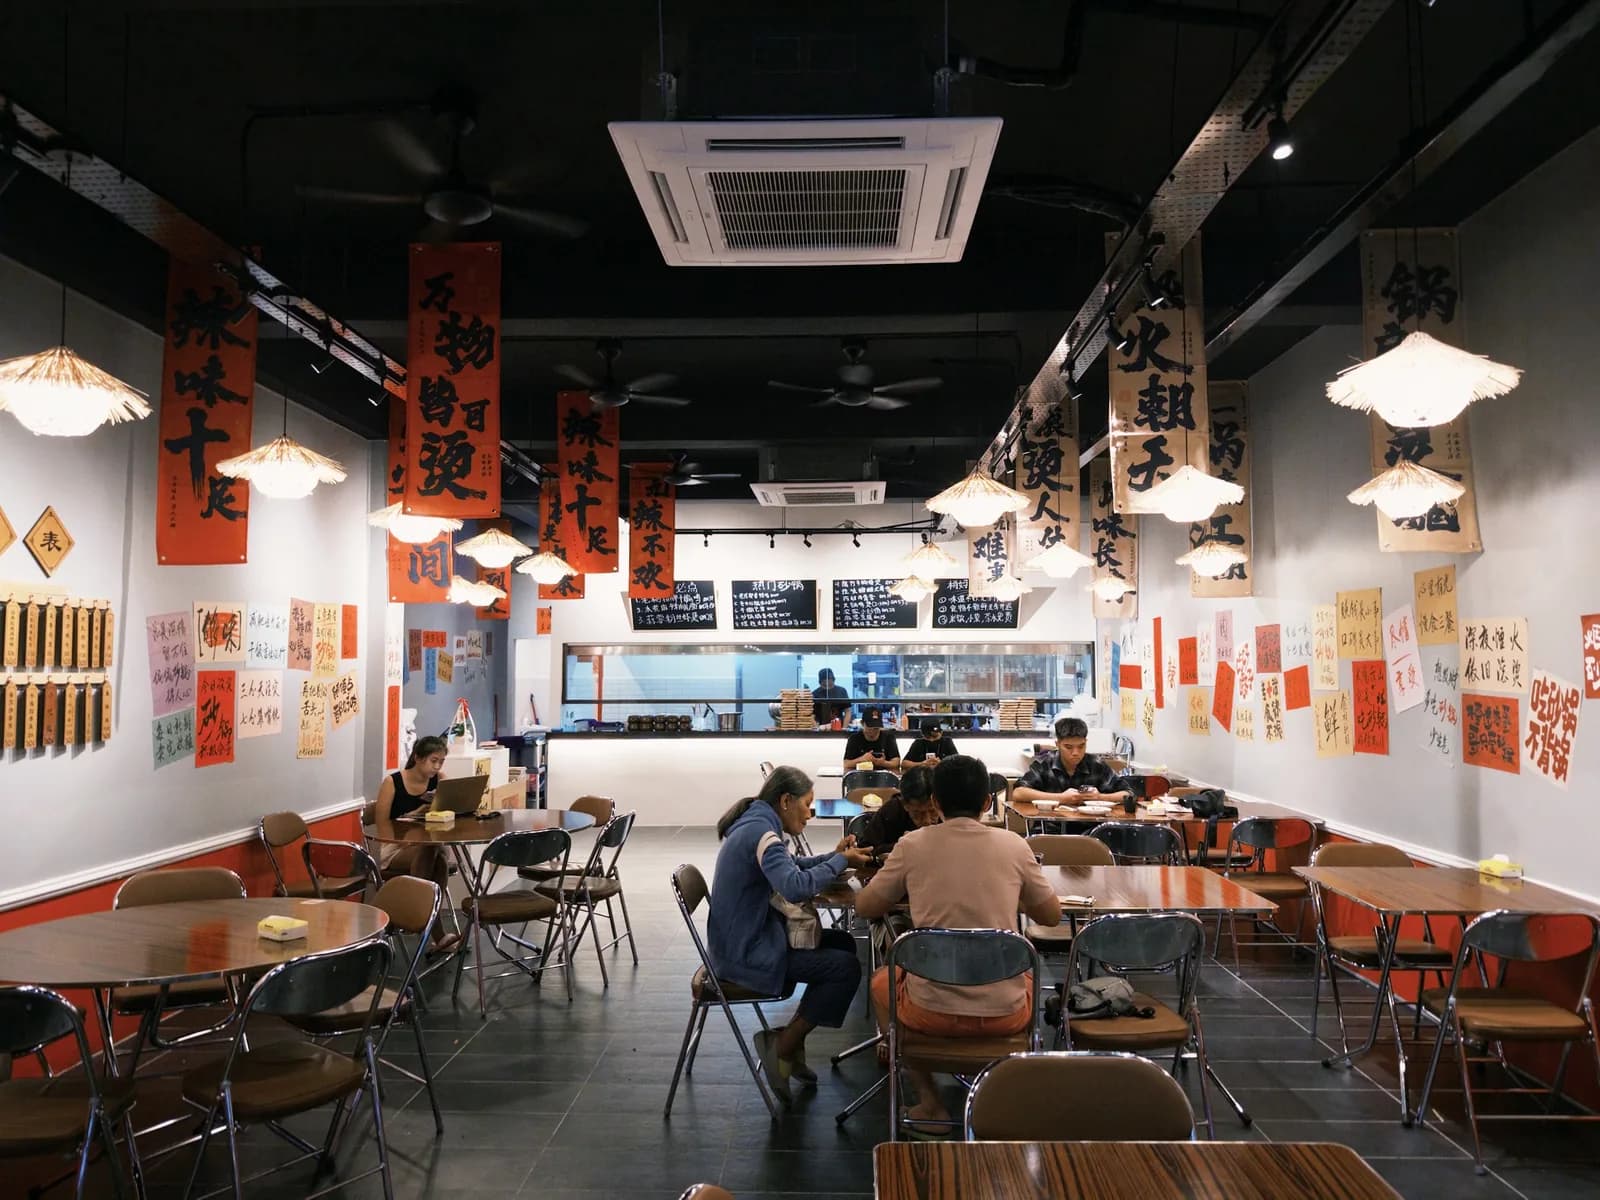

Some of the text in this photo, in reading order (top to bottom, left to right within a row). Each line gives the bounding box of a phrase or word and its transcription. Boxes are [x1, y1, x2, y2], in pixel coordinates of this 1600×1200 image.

[164, 287, 251, 522] 辣味十足
[39, 532, 62, 553] 表
[562, 408, 616, 555] 辣味十足
